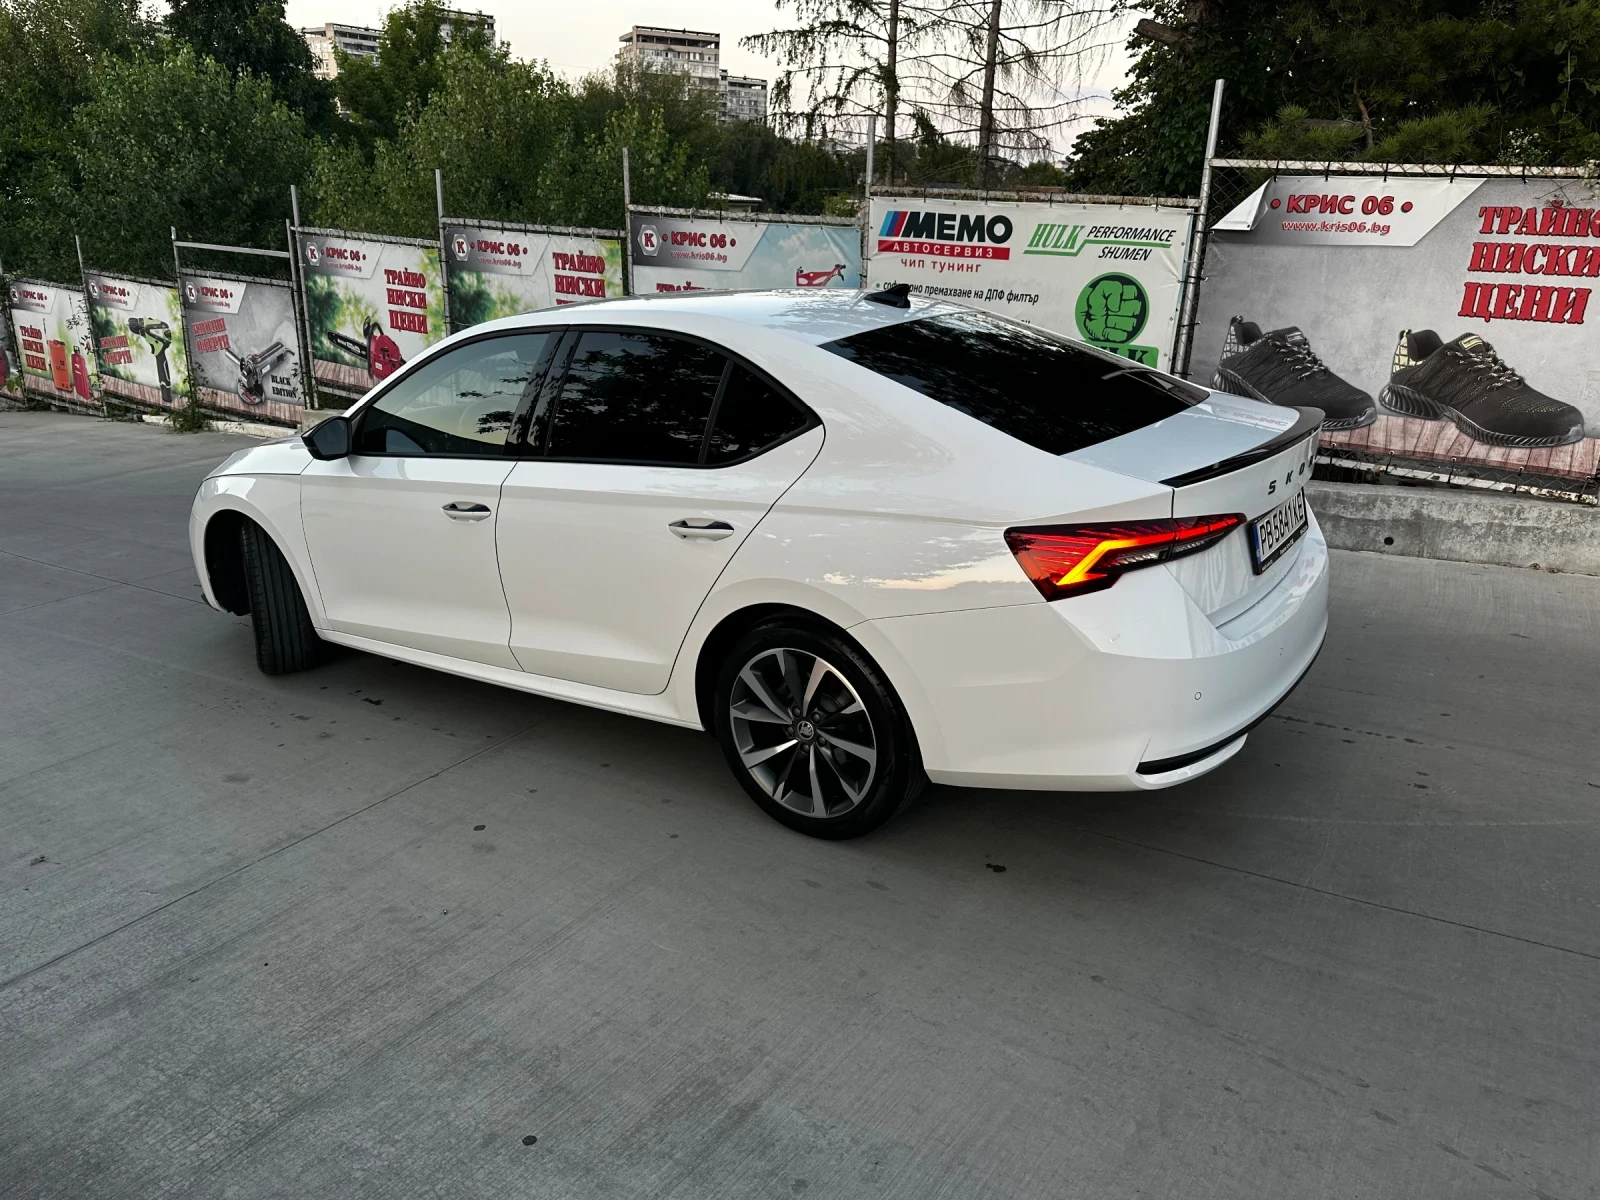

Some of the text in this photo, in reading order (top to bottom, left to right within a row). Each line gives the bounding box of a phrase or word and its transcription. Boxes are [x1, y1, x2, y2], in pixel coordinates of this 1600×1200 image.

[1286, 195, 1395, 215] КРИС 06
[1027, 223, 1176, 249] HULK PERFORMANCE
[1282, 220, 1391, 236] www.kris06.bg
[477, 239, 520, 256] КРИС 06
[671, 231, 727, 248] КРИС 06
[325, 246, 361, 262] КРИС 06
[671, 250, 728, 263] www.kris06.bg
[893, 242, 993, 258] АВТОСЕРВИЗ
[1098, 246, 1152, 261] SHUMEN
[477, 256, 522, 269] www.kris06.bg
[553, 250, 605, 274] ТРАЙНО
[901, 258, 982, 273] чип тунинг
[1467, 241, 1600, 277] НИСКИ
[384, 267, 426, 288] ТРАЙНО
[554, 275, 606, 297] НИСКИ
[102, 283, 118, 296] КРИС
[200, 285, 219, 297] КРИС
[924, 285, 971, 299] премахване
[973, 290, 983, 299] на
[984, 289, 1005, 301] ДПФ
[1006, 290, 1039, 305] филтър
[386, 288, 427, 309] НИСКИ
[1457, 282, 1592, 324] ЦЕНИ
[388, 310, 428, 334] ЦЕНИ
[271, 374, 292, 387] BLACK
[272, 386, 297, 399] EDITION
